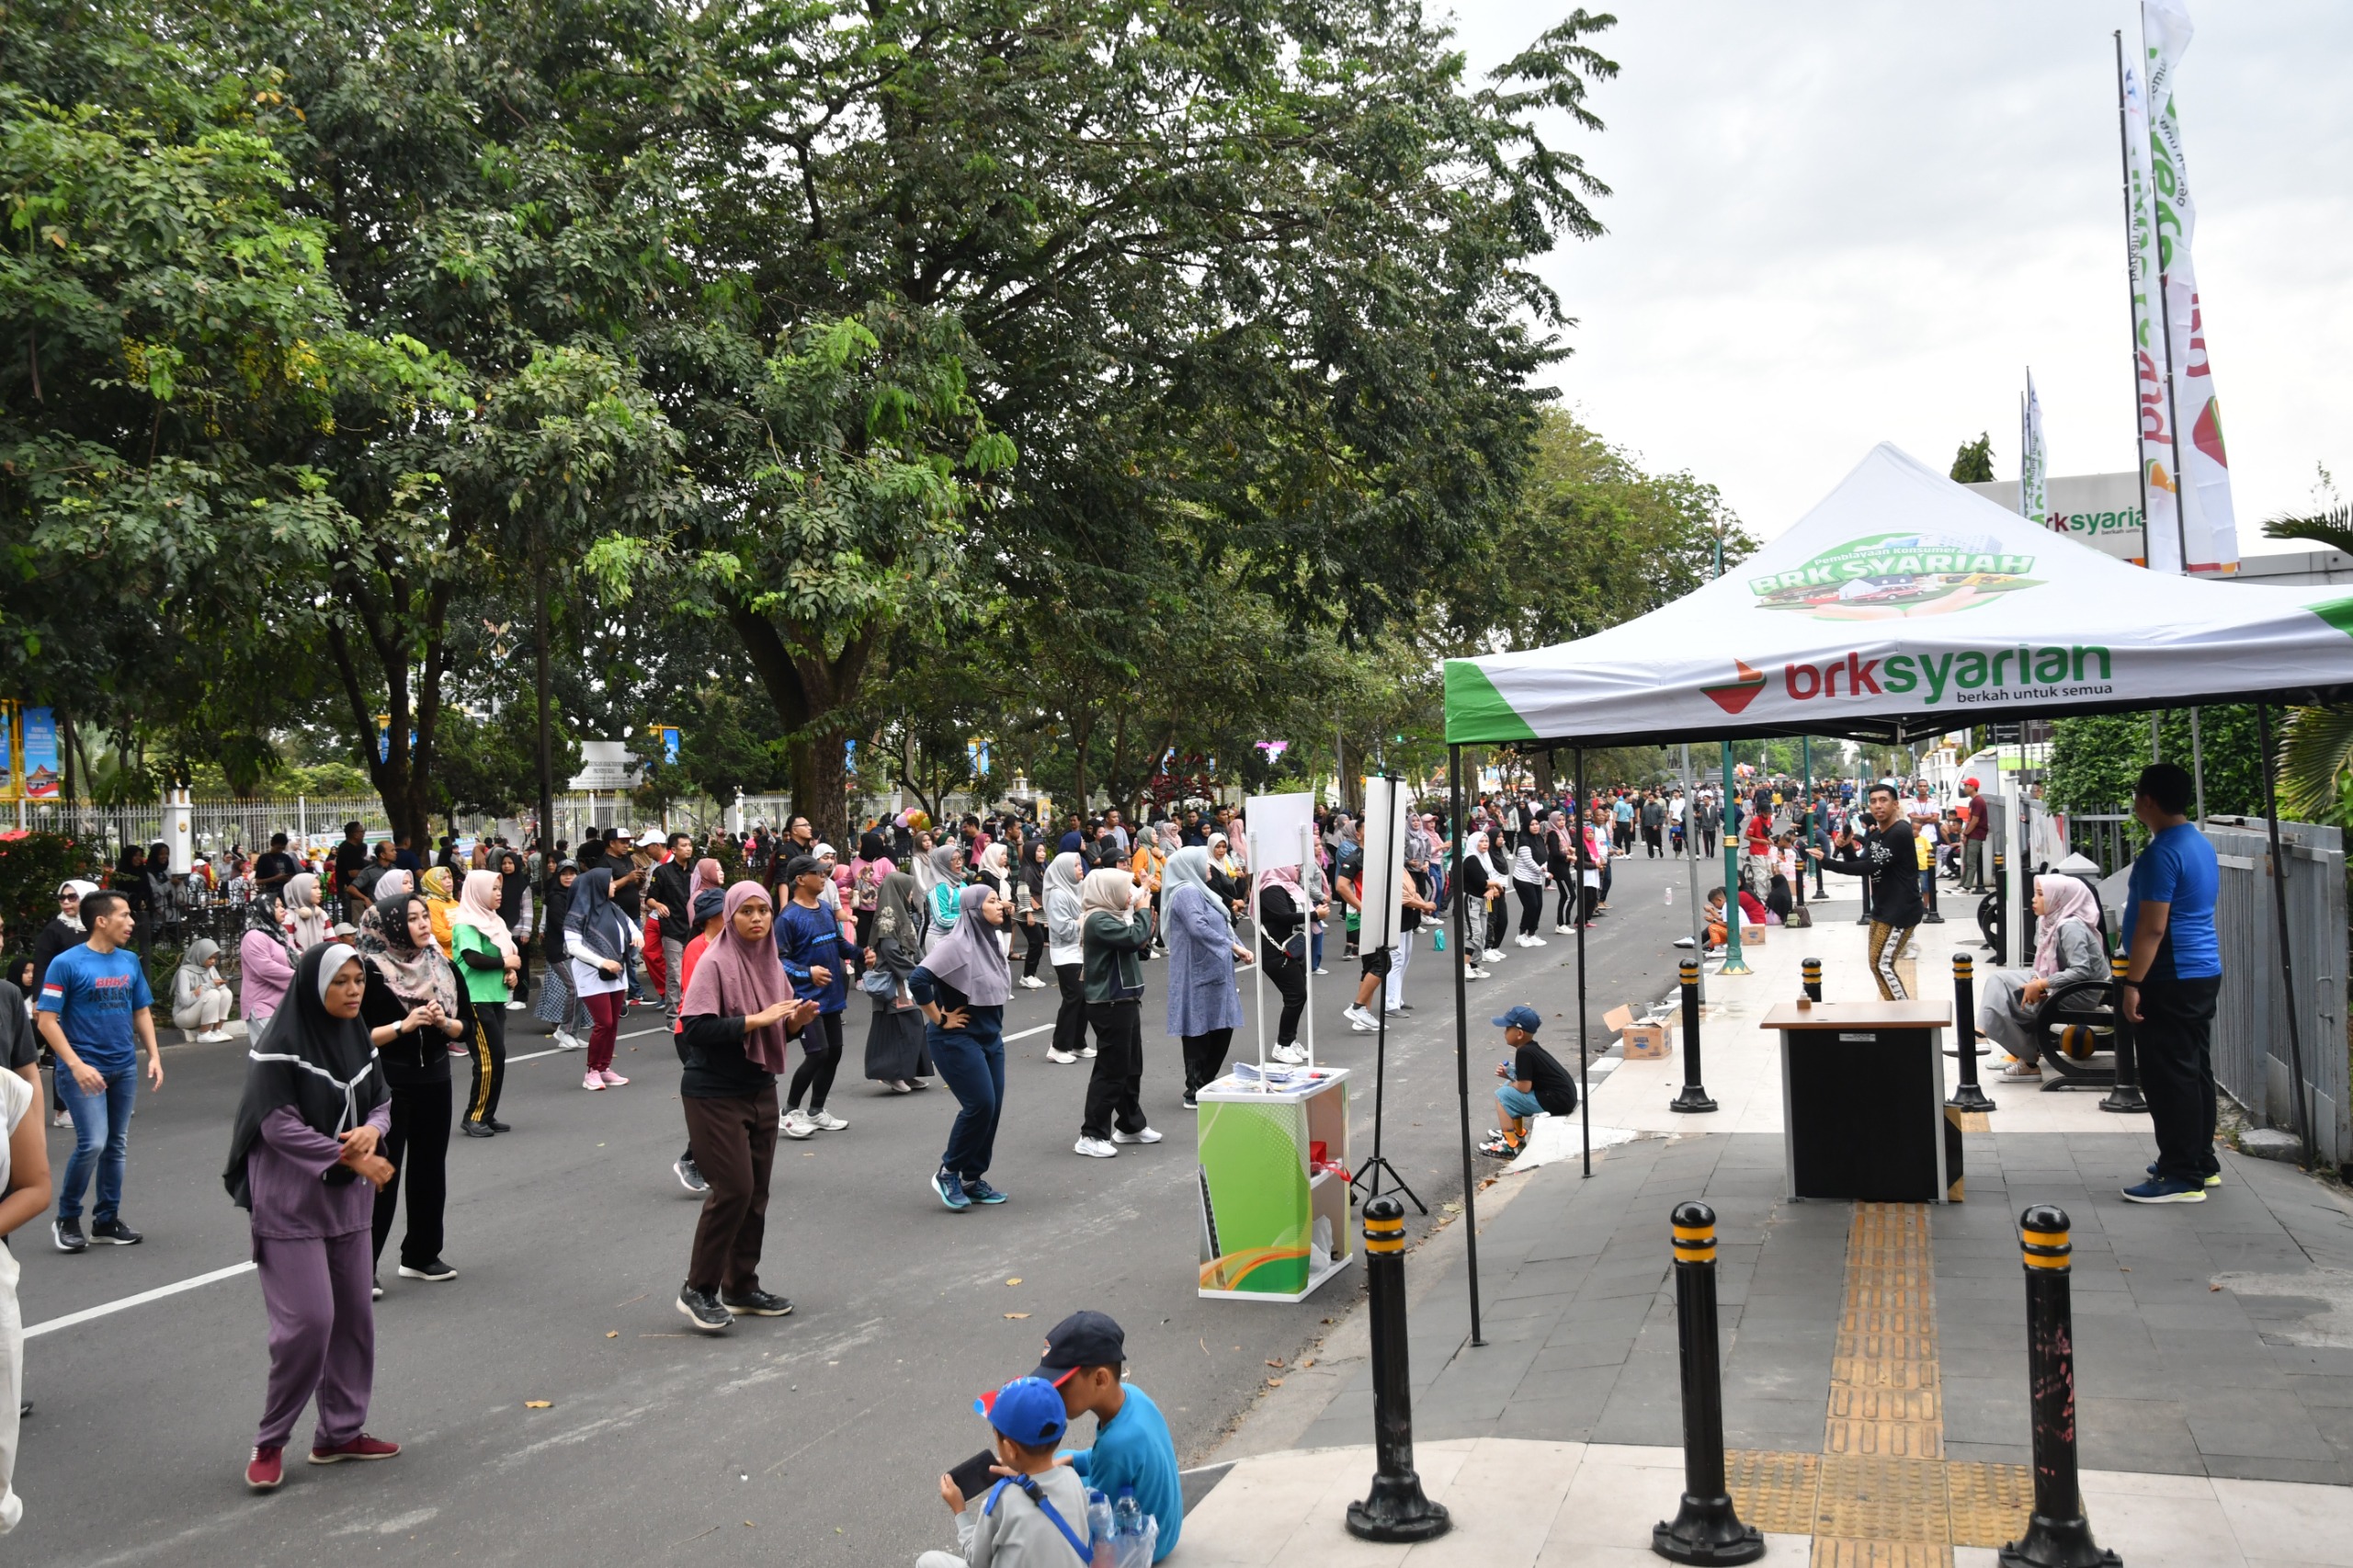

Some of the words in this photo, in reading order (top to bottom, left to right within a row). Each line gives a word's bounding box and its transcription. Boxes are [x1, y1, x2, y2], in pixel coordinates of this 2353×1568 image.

[1750, 562, 1837, 595] BRK
[1841, 554, 2033, 578] SYARIAH
[1957, 689, 2008, 704] berkah
[2013, 686, 2059, 699] untuk
[2062, 684, 2113, 699] semua
